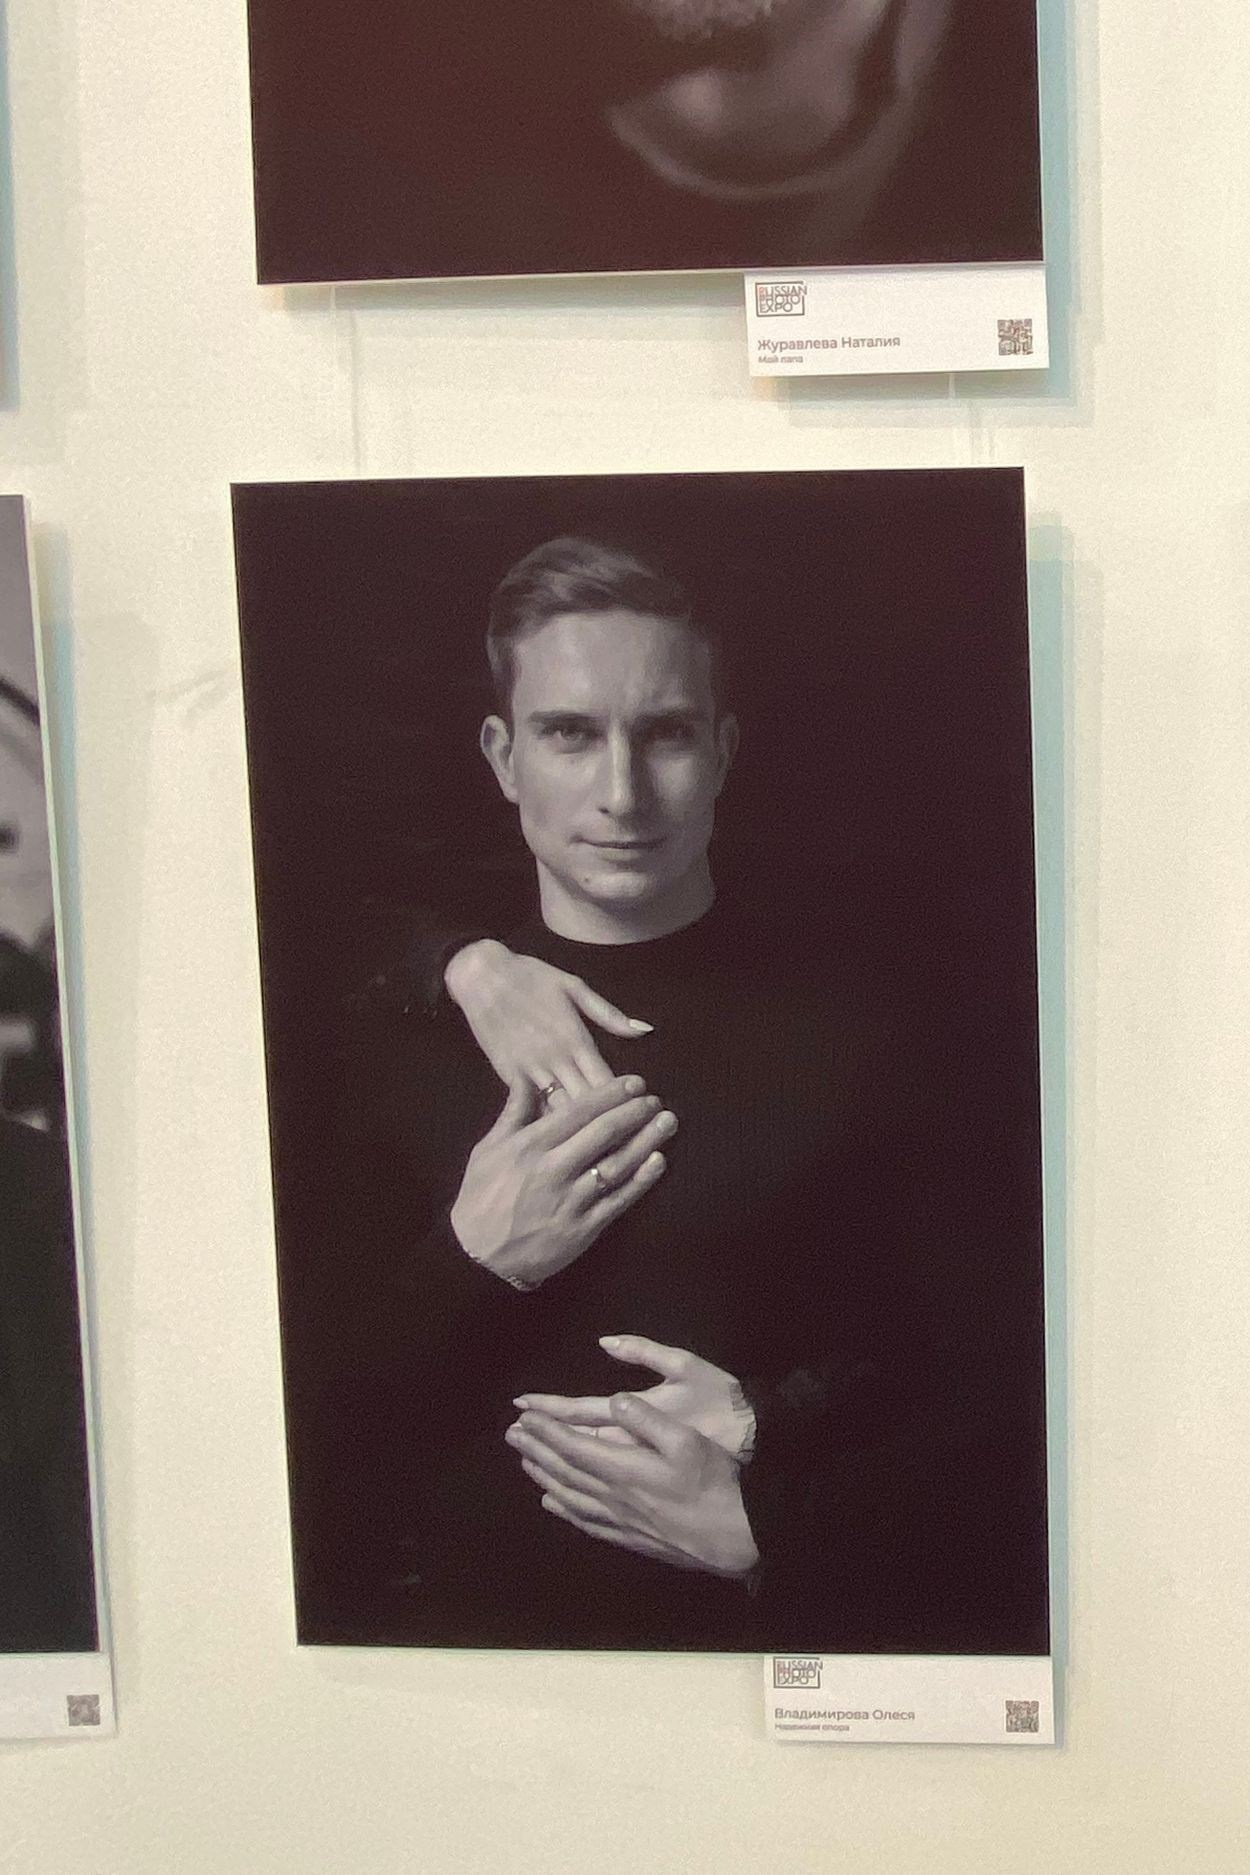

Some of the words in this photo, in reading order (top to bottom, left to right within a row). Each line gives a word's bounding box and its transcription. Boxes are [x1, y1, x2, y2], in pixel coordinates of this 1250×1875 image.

[758, 285, 808, 297] RUSSIAN
[759, 294, 801, 305] PHOTO
[759, 302, 793, 313] EXPO
[757, 339, 838, 353] Журавлева
[841, 337, 901, 349] Наталия
[777, 1660, 823, 1670] RUSSIAN
[777, 1668, 816, 1678] PHOTO
[777, 1676, 809, 1685] EXPO
[774, 1708, 869, 1721] Владимирова
[872, 1709, 916, 1720] Олеся
